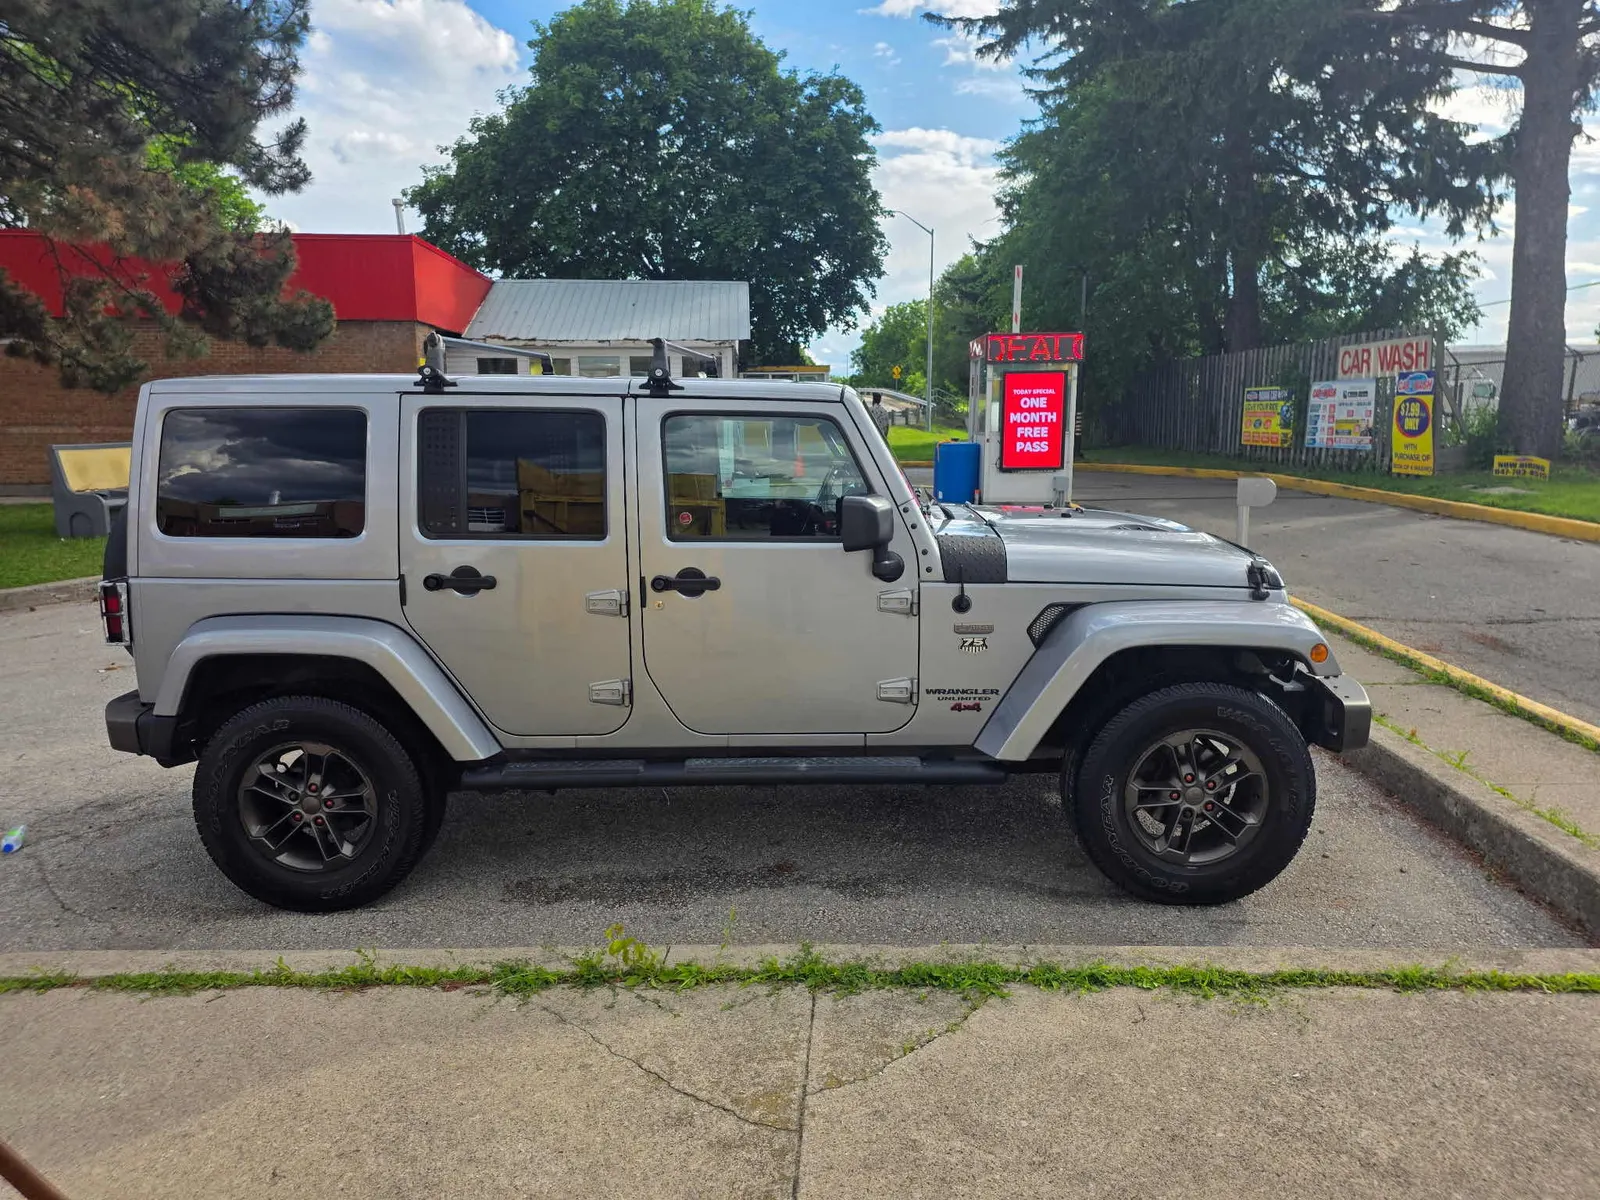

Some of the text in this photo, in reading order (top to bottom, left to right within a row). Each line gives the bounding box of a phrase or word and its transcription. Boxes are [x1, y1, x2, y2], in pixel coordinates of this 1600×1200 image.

[1341, 340, 1428, 375] CAR WASH
[1020, 397, 1047, 408] ONE
[1010, 412, 1057, 423] MONTH
[1016, 427, 1049, 438] FREE
[1016, 441, 1049, 452] PASS
[1403, 442, 1418, 451] WITH
[1394, 452, 1432, 462] PURCHASE OF
[963, 638, 984, 646] 75
[950, 702, 982, 712] 4x4
